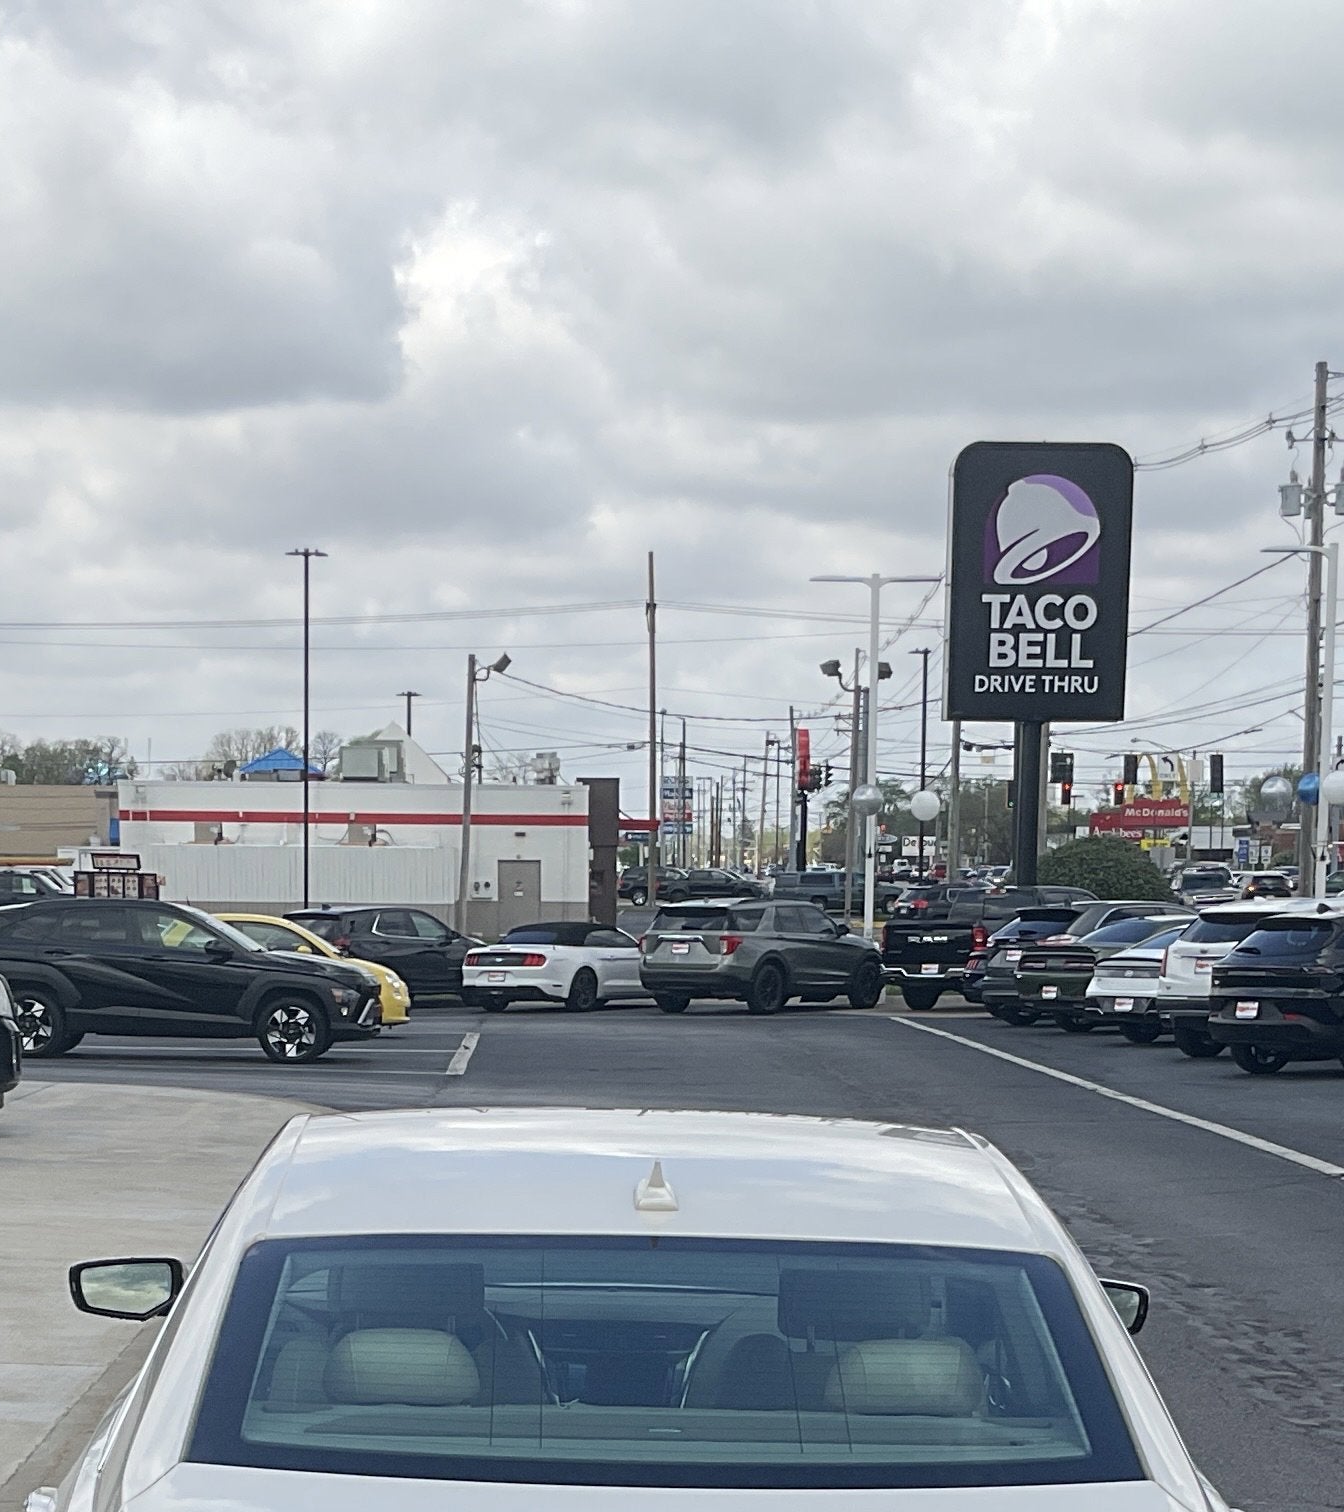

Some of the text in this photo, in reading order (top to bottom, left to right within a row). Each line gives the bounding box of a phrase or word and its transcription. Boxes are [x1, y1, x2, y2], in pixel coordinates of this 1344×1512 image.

[982, 594, 1098, 631] TACO
[989, 633, 1094, 669] BELL
[974, 674, 1099, 694] DRIVE THRU
[1124, 807, 1189, 817] McDonald's
